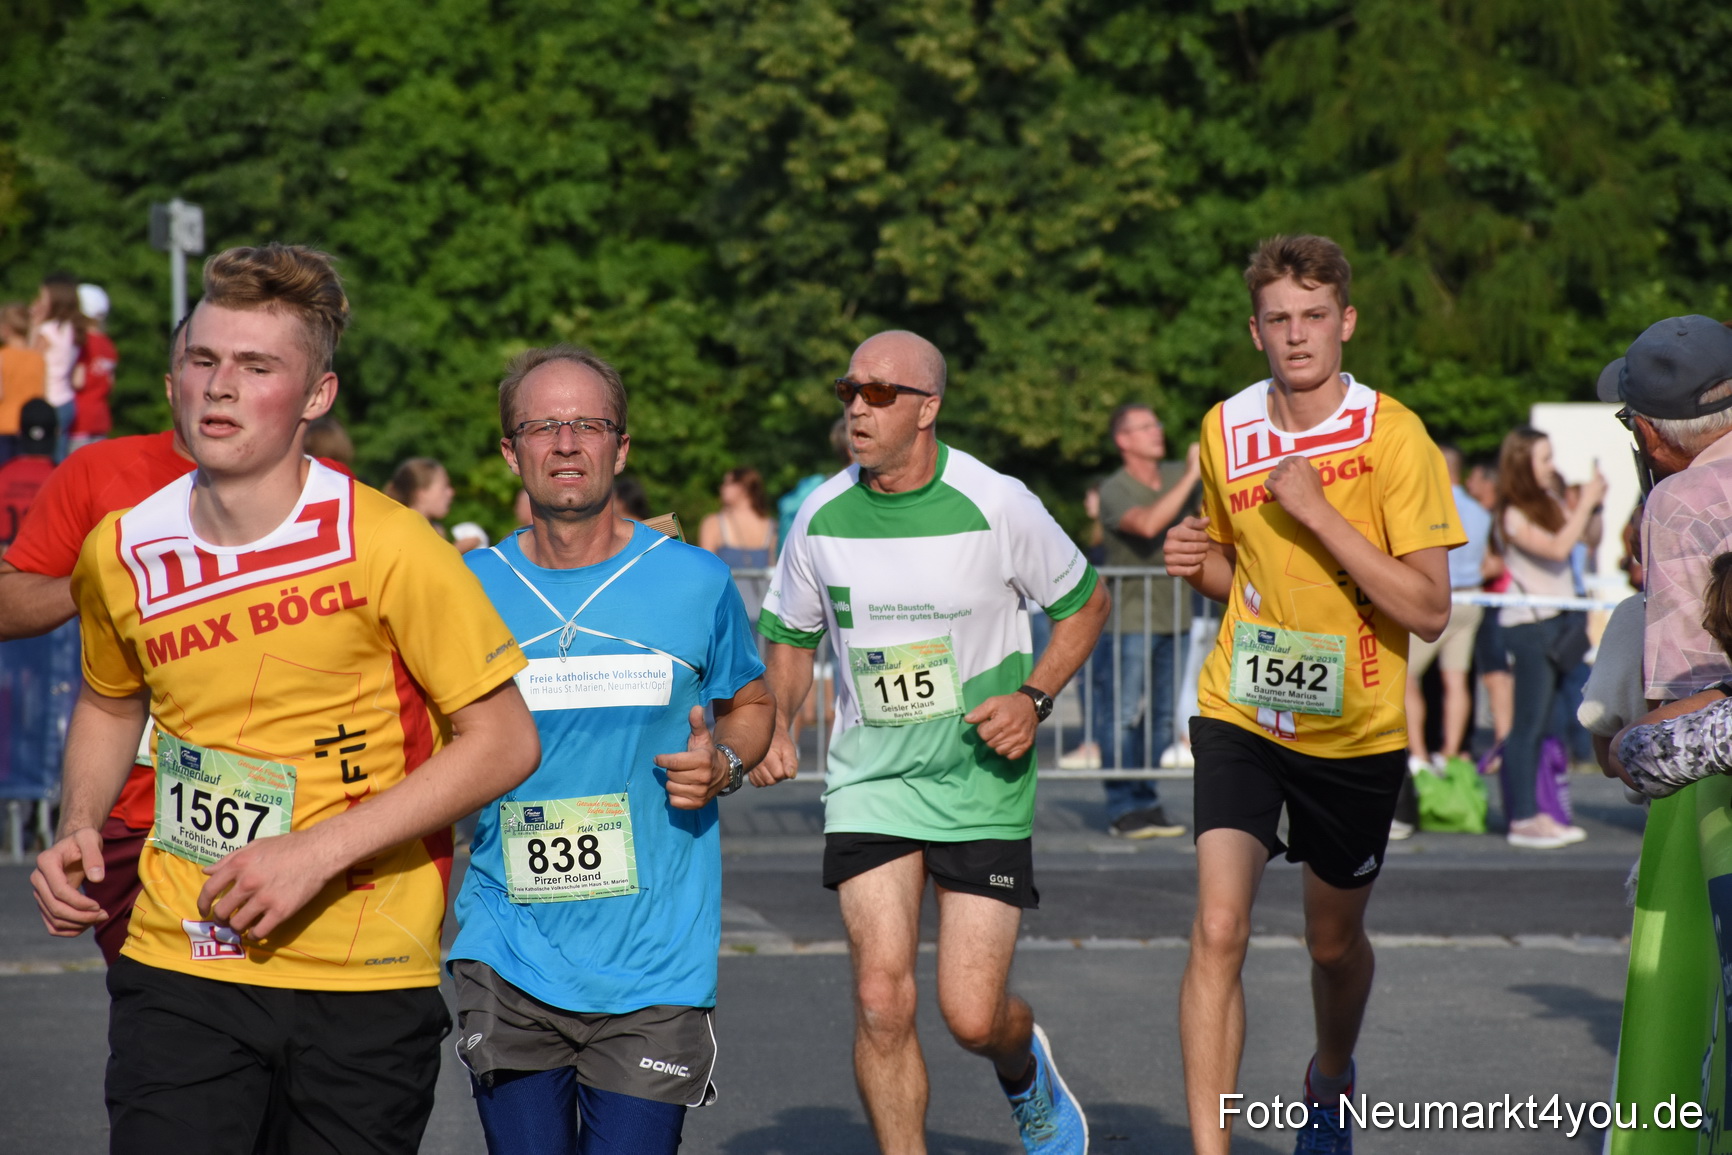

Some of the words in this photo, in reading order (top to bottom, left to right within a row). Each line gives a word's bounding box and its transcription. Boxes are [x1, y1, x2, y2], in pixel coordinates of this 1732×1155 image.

[1318, 455, 1374, 487] ÖGL
[868, 604, 896, 613] BayWa
[898, 603, 935, 611] Baustoffe
[870, 613, 894, 621] Immer
[910, 612, 932, 622] gutes
[933, 609, 972, 621] Baugefühl
[144, 612, 239, 668] MAX
[248, 580, 368, 636] BÖGL
[928, 658, 948, 668] 2019
[1316, 655, 1338, 663] 2019
[530, 674, 553, 684] Freie
[556, 671, 610, 682] katholische
[612, 669, 667, 679] Volksschule
[1246, 654, 1328, 692] 1542
[530, 686, 540, 695] im
[542, 685, 563, 694] Haus
[564, 685, 575, 693] St.
[575, 683, 606, 693] Marien,
[608, 680, 667, 693] Neumarkt/Opf.
[874, 670, 934, 704] 115
[1254, 685, 1286, 697] Baumer
[1288, 690, 1317, 700] Marius
[881, 704, 908, 713] Geisler
[910, 700, 935, 709] Klaus
[1305, 699, 1325, 707] GmbH
[172, 760, 221, 785] firmenlauf
[255, 792, 283, 806] 2019
[170, 782, 270, 844] 1567
[517, 819, 565, 832] firmenlauf
[597, 821, 622, 831] 2019
[171, 835, 183, 846] Max
[184, 839, 199, 853] Bögl
[179, 826, 218, 848] Fröhlich
[527, 834, 602, 874] 838
[534, 876, 562, 885] Pirzer
[565, 871, 601, 884] Roland
[990, 874, 1014, 885] GORE
[639, 1057, 689, 1077] DONIC
